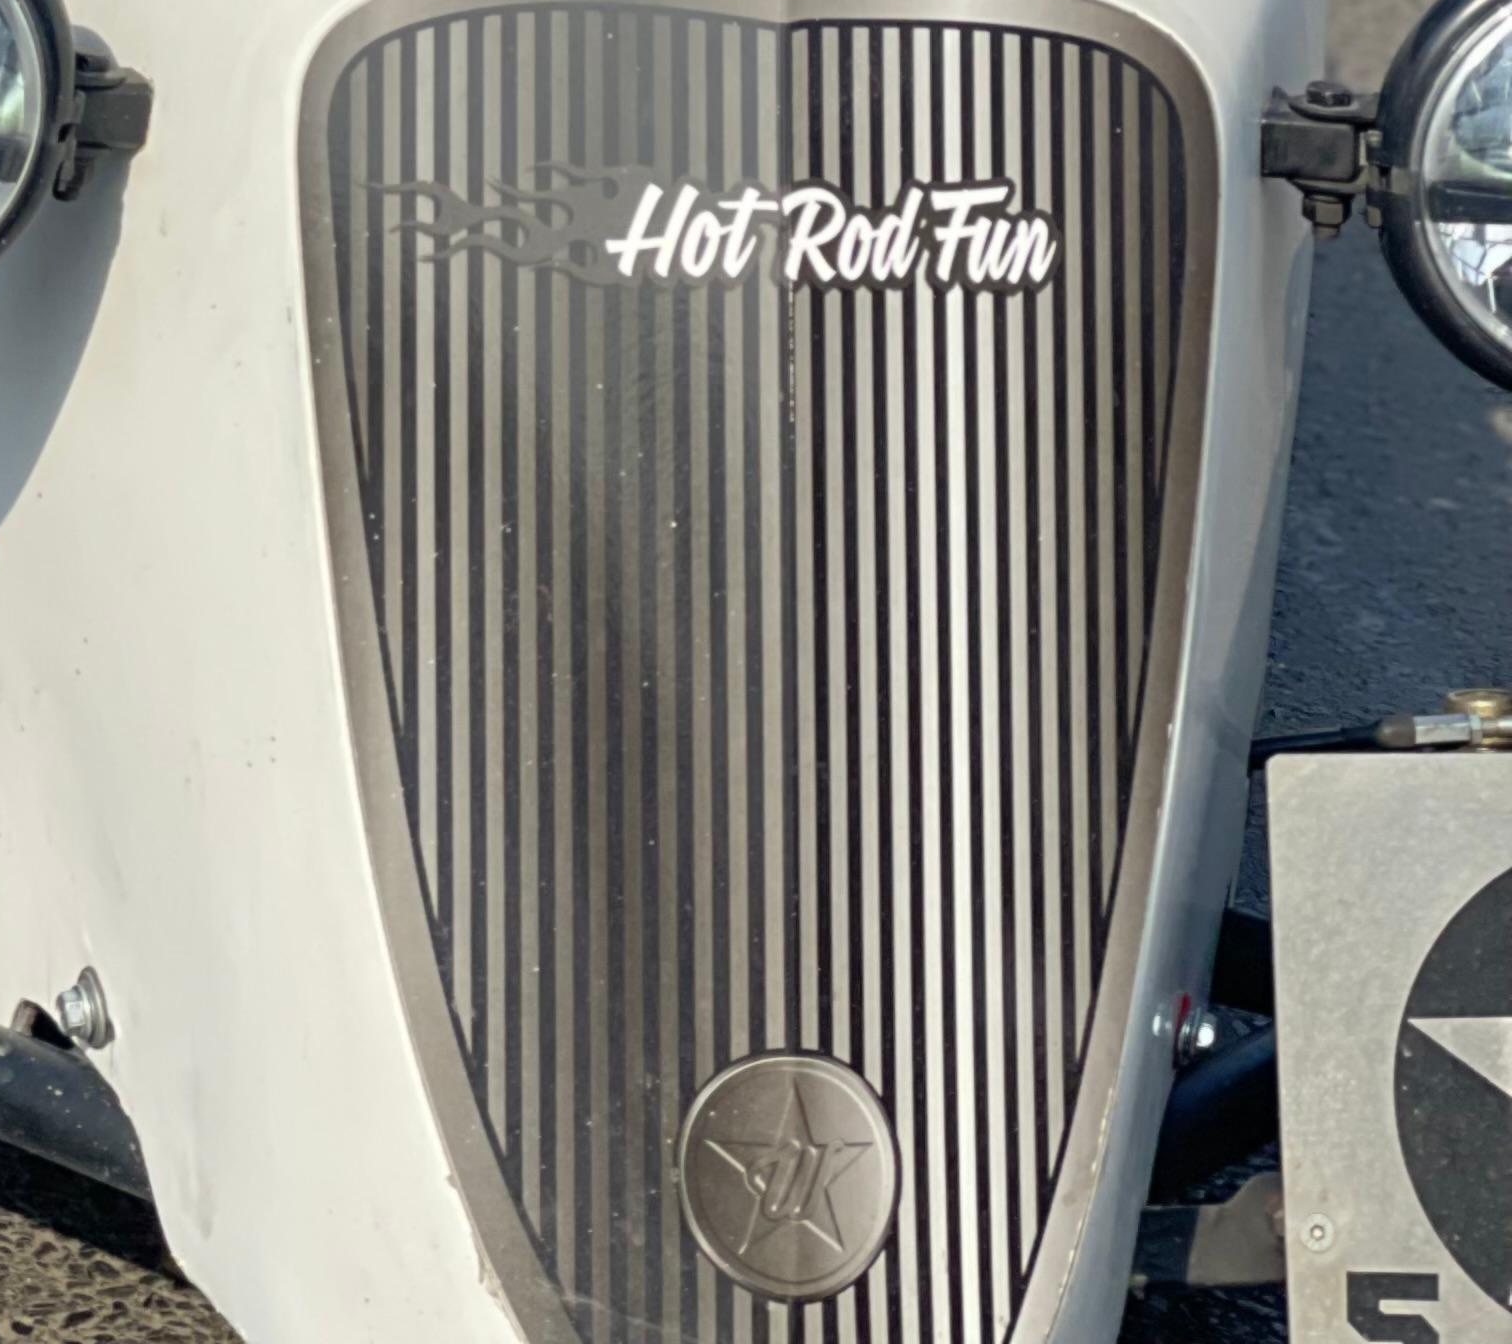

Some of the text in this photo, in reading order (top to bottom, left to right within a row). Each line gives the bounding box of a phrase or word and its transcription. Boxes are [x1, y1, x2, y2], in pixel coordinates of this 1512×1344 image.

[605, 182, 1058, 285] Hot Rod Fun
